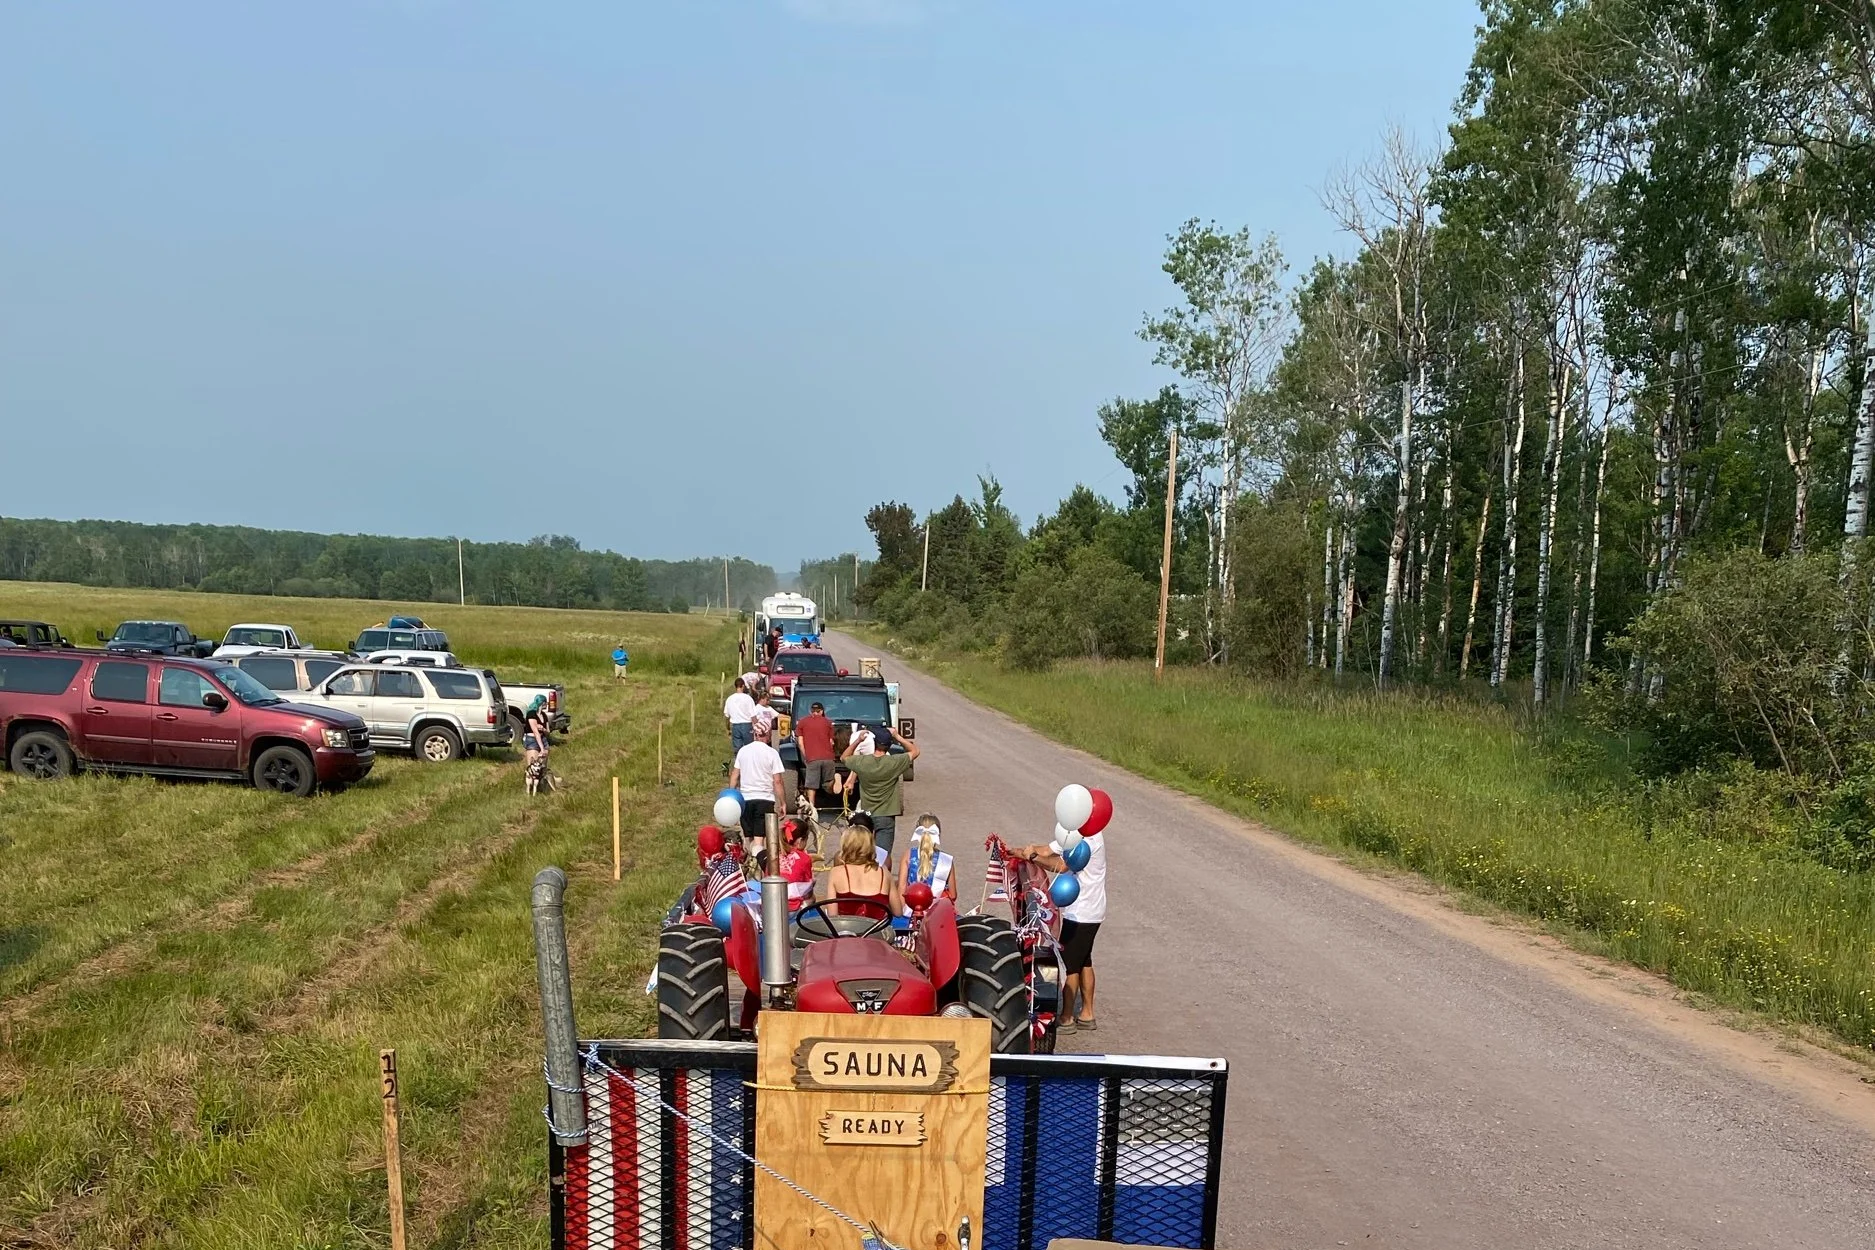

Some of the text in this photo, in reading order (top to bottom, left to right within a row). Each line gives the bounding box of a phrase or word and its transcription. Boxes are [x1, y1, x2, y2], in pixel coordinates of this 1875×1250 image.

[856, 1001, 883, 1011] M F
[823, 1051, 928, 1078] SAUNA
[842, 1118, 905, 1135] READY
